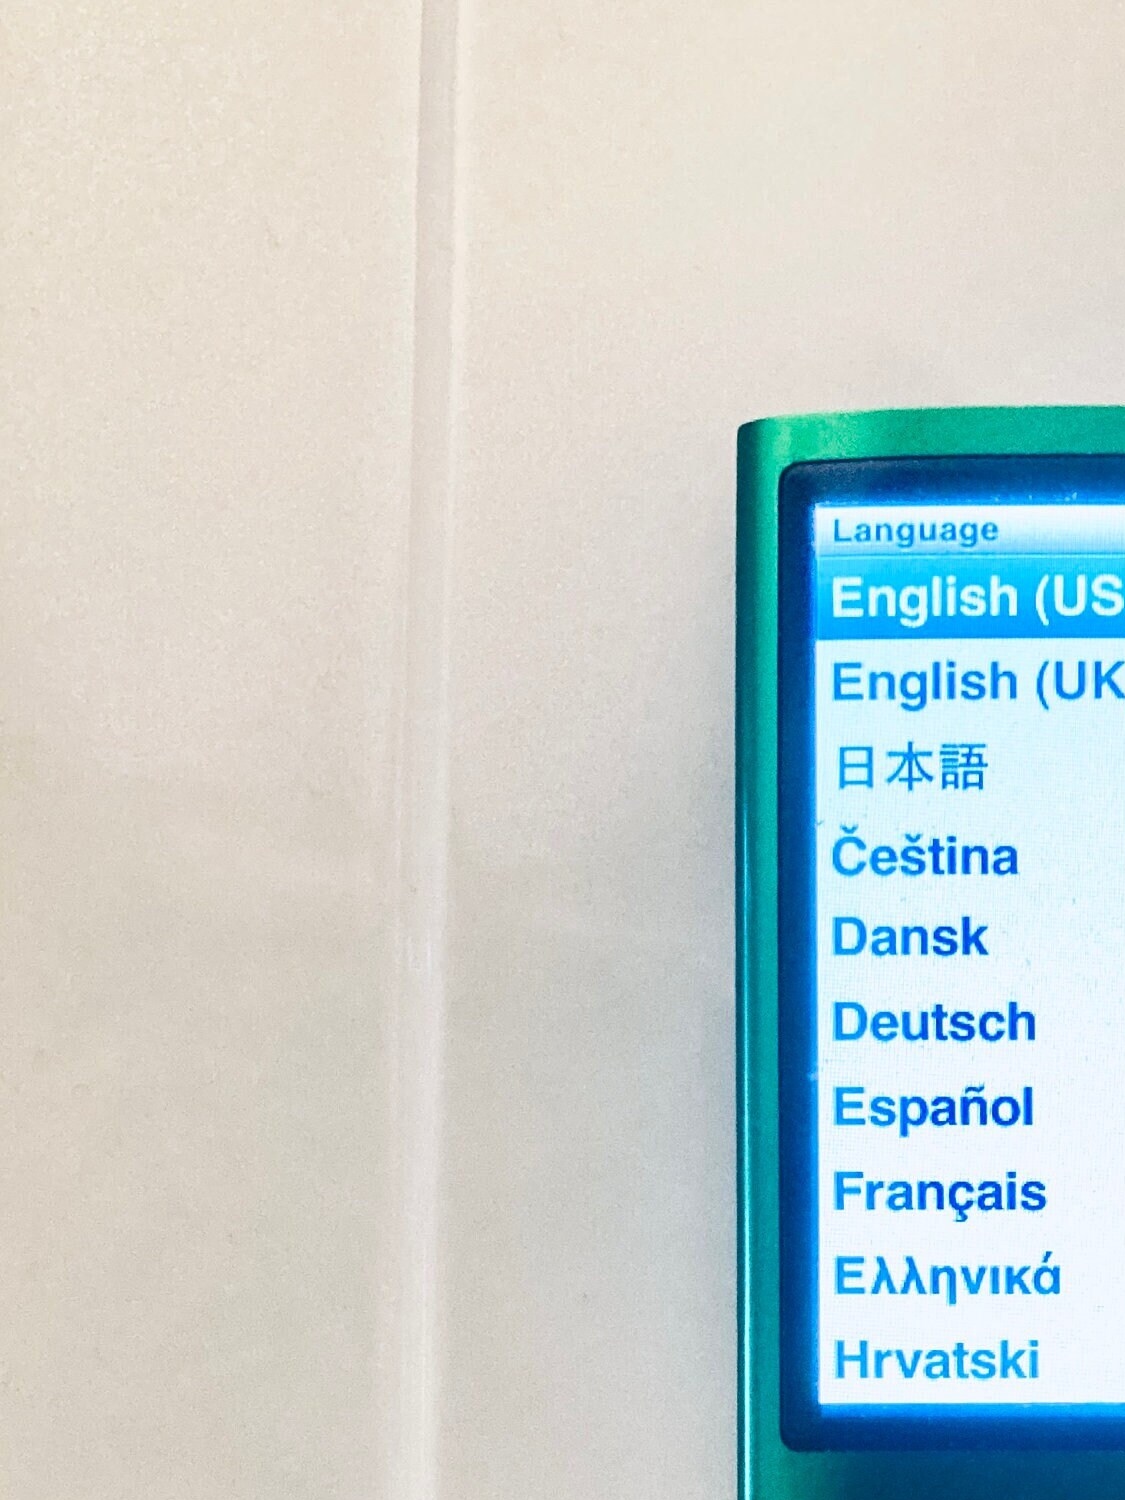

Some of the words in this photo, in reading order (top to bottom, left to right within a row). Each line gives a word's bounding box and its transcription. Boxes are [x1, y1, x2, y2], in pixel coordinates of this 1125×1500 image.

[832, 517, 1000, 547] Language
[831, 575, 1019, 628] English
[832, 660, 1019, 712] English
[837, 740, 989, 792] 日本語
[831, 825, 1020, 877] Čeština
[832, 916, 990, 957] Dansk
[833, 1001, 1037, 1042] Deutsch
[833, 1083, 1034, 1138] Español
[833, 1171, 1048, 1223] Français
[834, 1251, 1062, 1306] Ελληνικά
[835, 1340, 1040, 1380] Hrvatski
